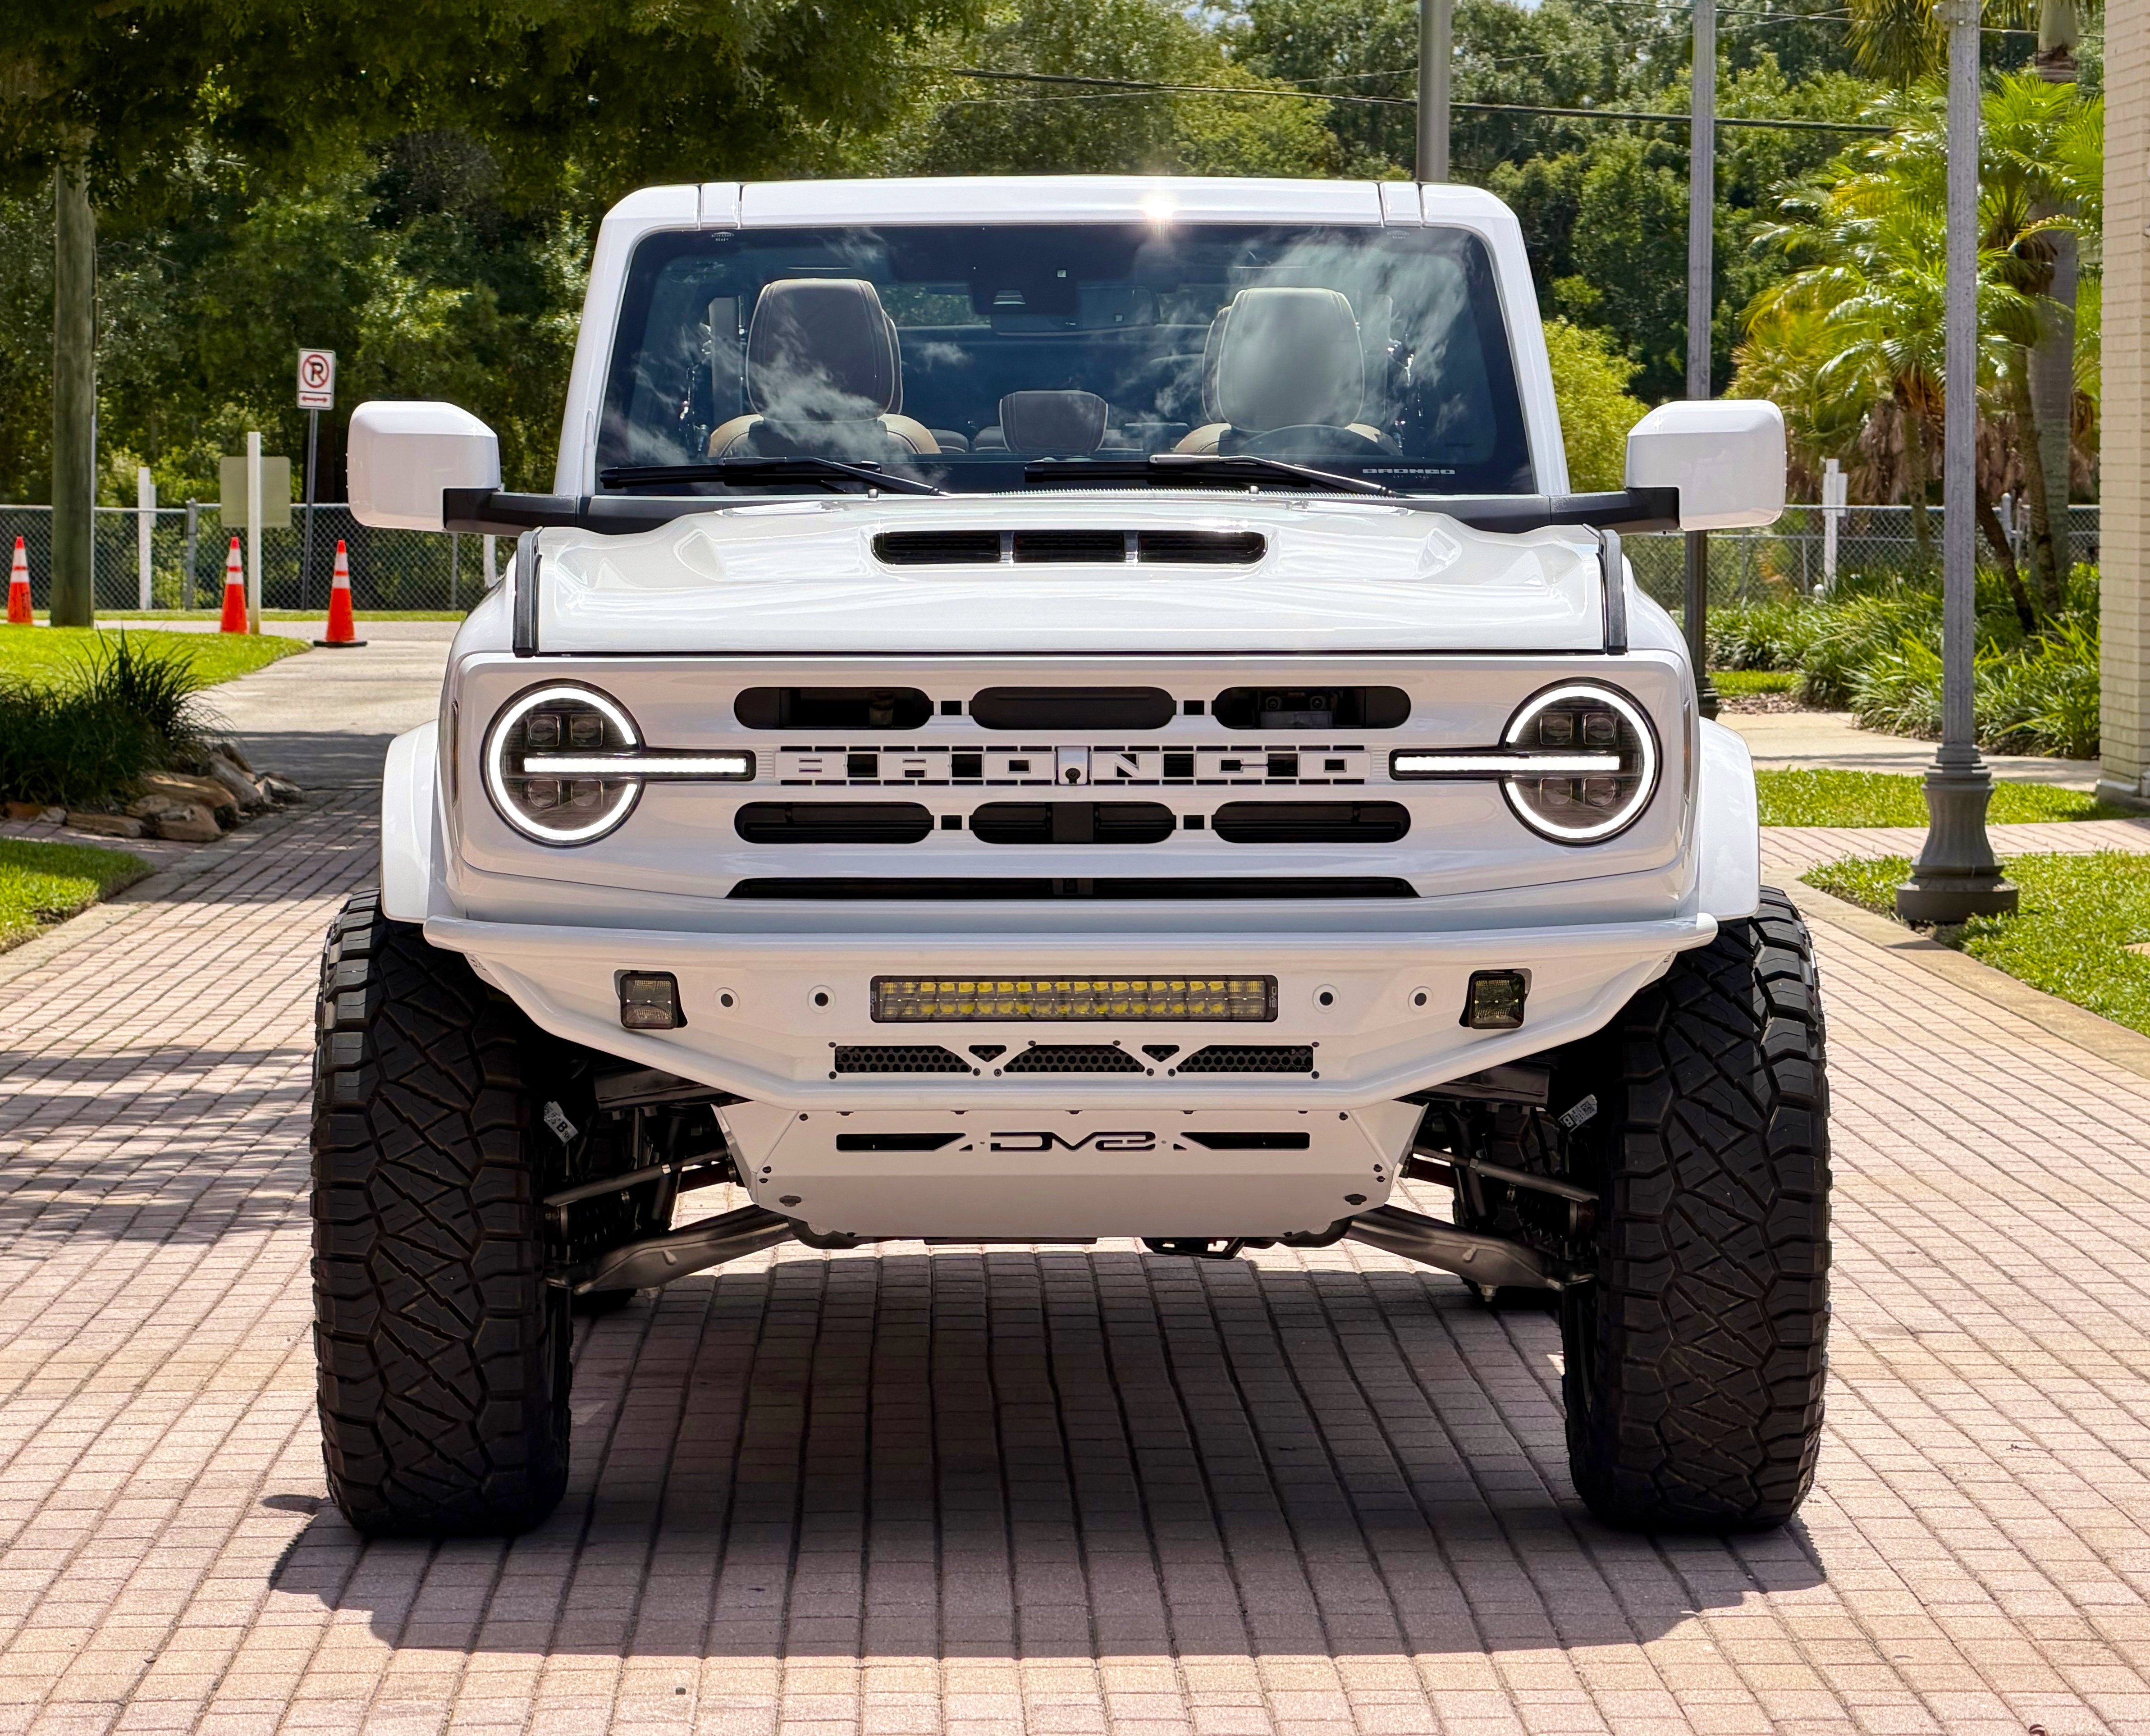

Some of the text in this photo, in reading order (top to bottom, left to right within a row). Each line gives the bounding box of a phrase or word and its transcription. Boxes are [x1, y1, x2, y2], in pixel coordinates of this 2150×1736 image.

[311, 362, 323, 382] P
[775, 752, 1370, 778] BRONCO
[556, 1121, 567, 1132] B
[990, 1132, 1156, 1151] DV8
